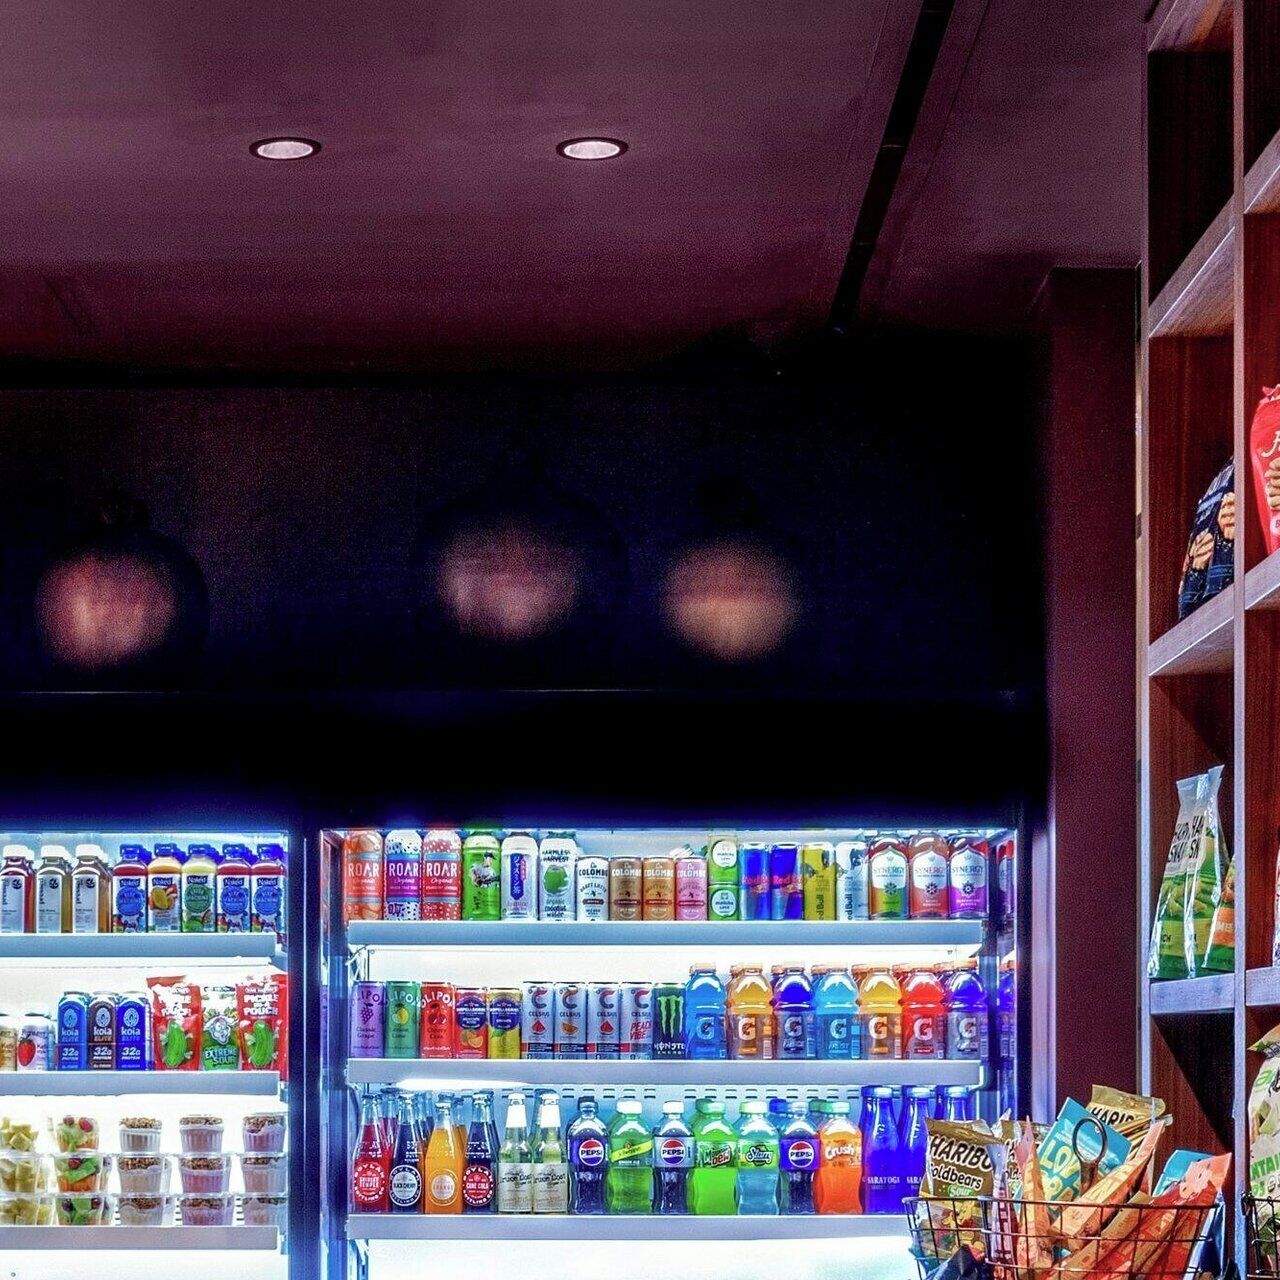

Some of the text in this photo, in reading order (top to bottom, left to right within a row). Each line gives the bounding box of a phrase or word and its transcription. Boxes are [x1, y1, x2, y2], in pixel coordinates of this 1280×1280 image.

[348, 862, 379, 877] ROAR
[389, 862, 419, 877] ROAR
[426, 862, 457, 877] ROAR
[61, 1027, 79, 1036] koia
[94, 1027, 112, 1036] koia
[121, 1027, 139, 1036] koia
[959, 1017, 977, 1039] G
[580, 1149, 603, 1157] PEPSI
[662, 1149, 684, 1157] PEPSI
[790, 1149, 813, 1157] PEPSI
[930, 1136, 994, 1172] HARIBO
[867, 1176, 900, 1184] SARATOGA
